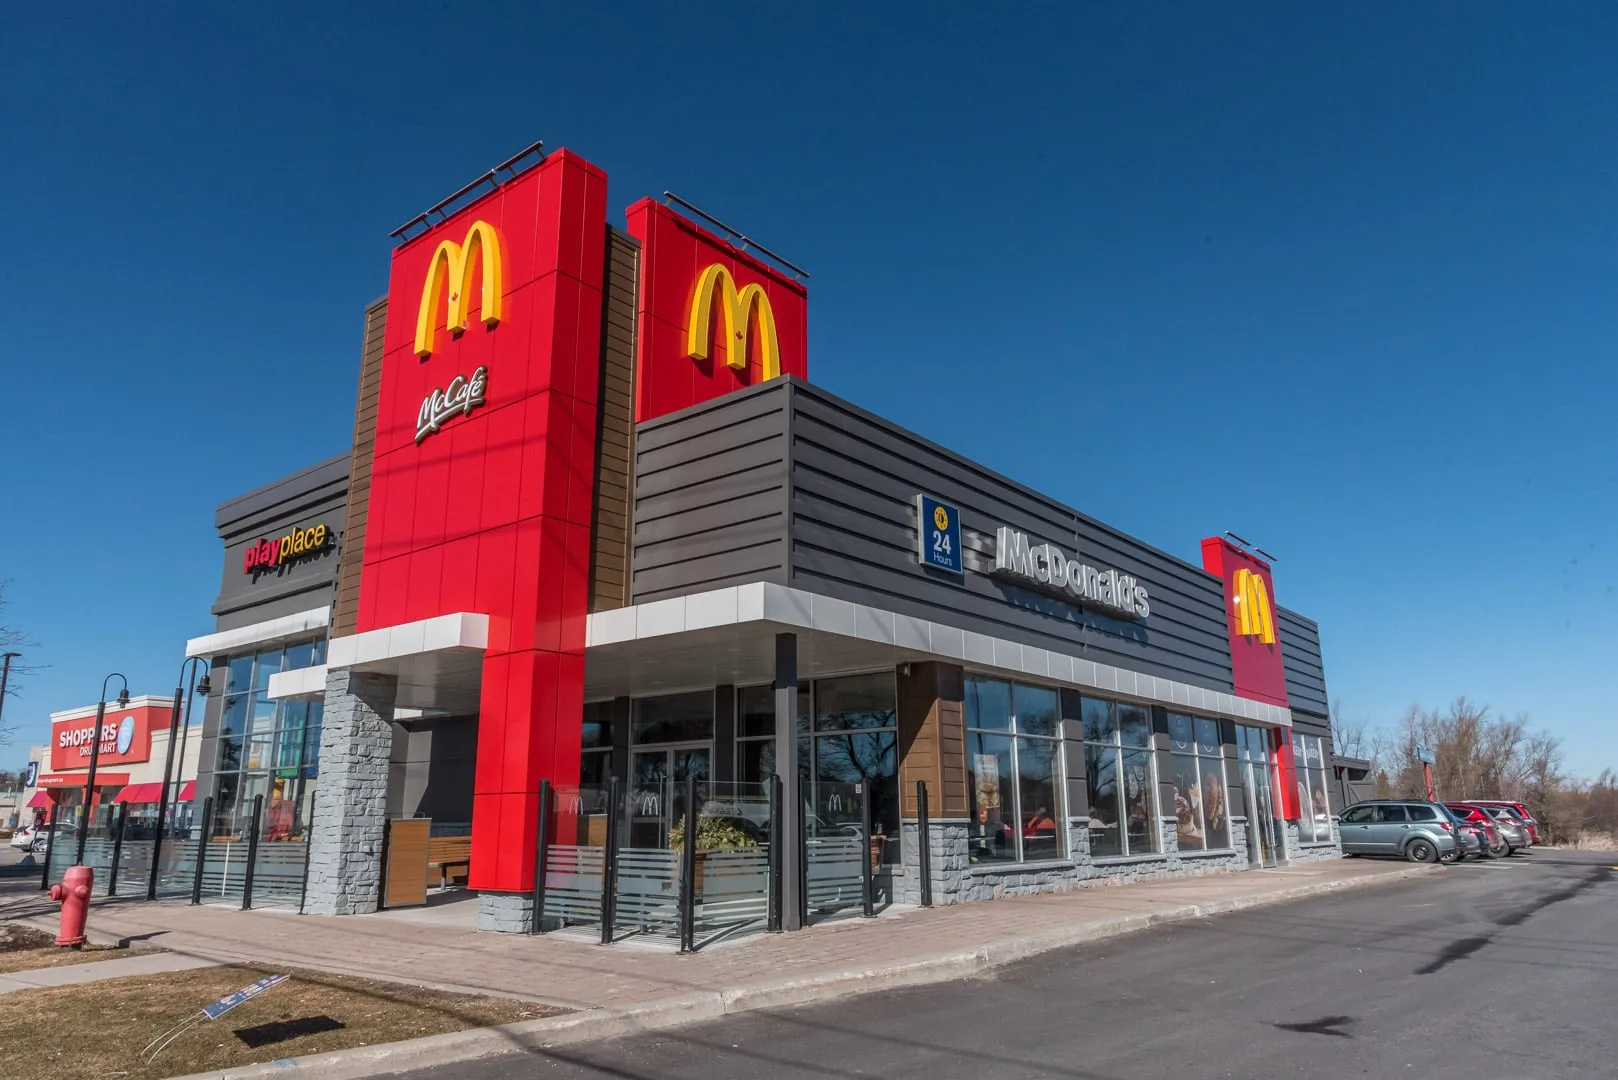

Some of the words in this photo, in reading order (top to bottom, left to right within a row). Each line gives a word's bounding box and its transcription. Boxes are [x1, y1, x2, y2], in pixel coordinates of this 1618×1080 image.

[415, 365, 487, 436] McCafé
[243, 523, 326, 575] playplace
[932, 530, 952, 555] 24
[933, 552, 953, 566] Hours
[996, 526, 1150, 618] McDonald's
[59, 723, 117, 748] SHOPPRS
[79, 747, 95, 757] DRU
